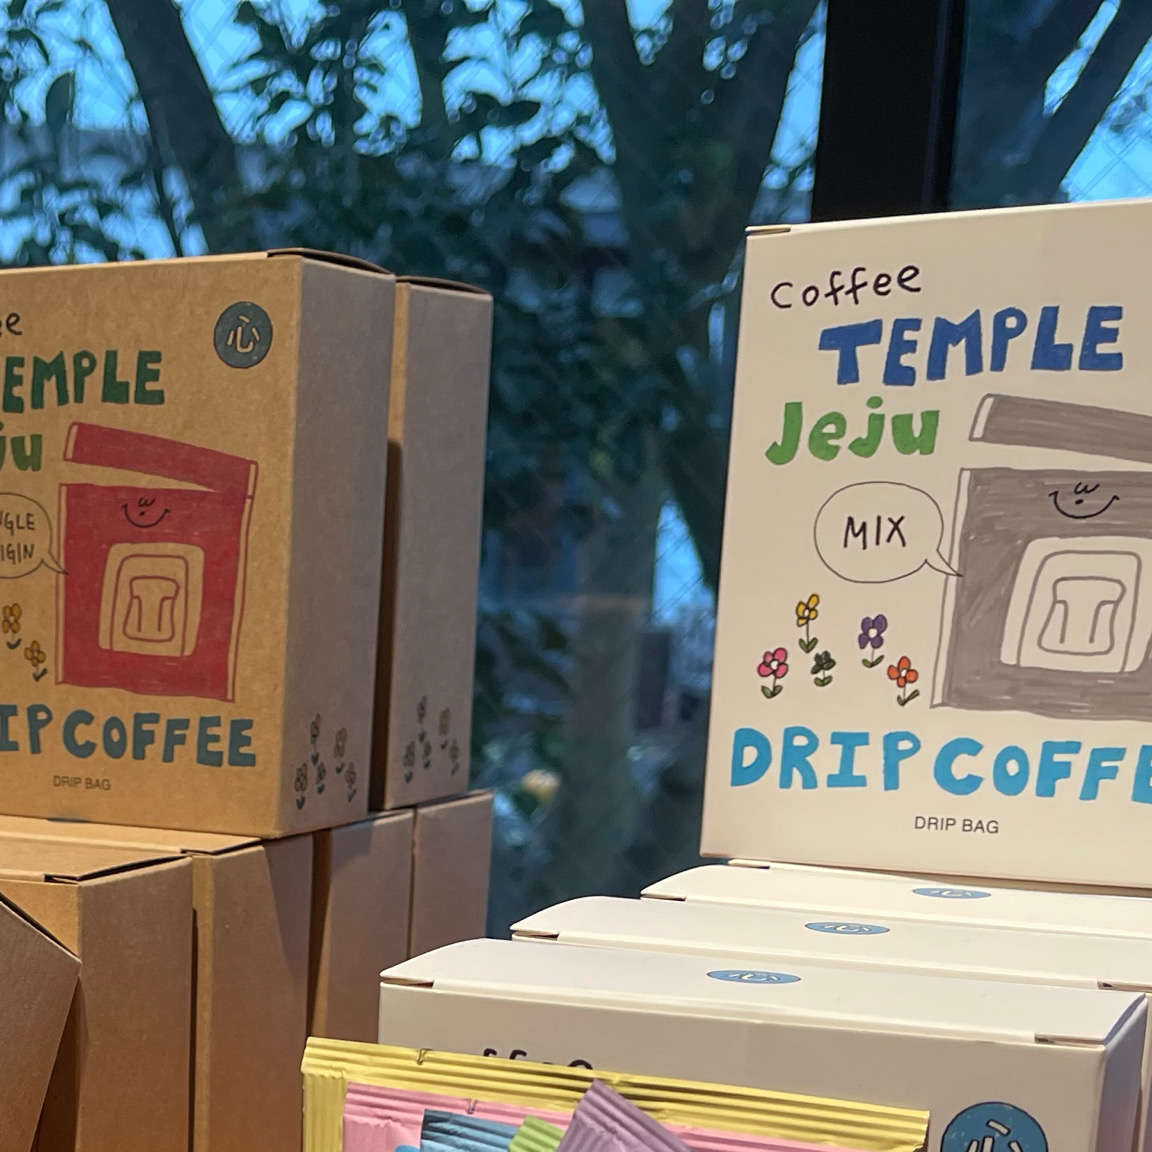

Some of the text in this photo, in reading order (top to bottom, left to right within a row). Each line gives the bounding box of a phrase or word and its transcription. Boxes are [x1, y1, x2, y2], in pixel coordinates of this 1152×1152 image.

[770, 265, 922, 309] Coffee
[818, 306, 1123, 386] TEMPLE
[765, 396, 940, 465] Jeju
[844, 516, 907, 549] MIX
[62, 709, 257, 767] COFFEE
[731, 726, 921, 790] DRIP
[53, 775, 111, 791] DRIP BAG
[914, 816, 999, 834] DRIP BAG
